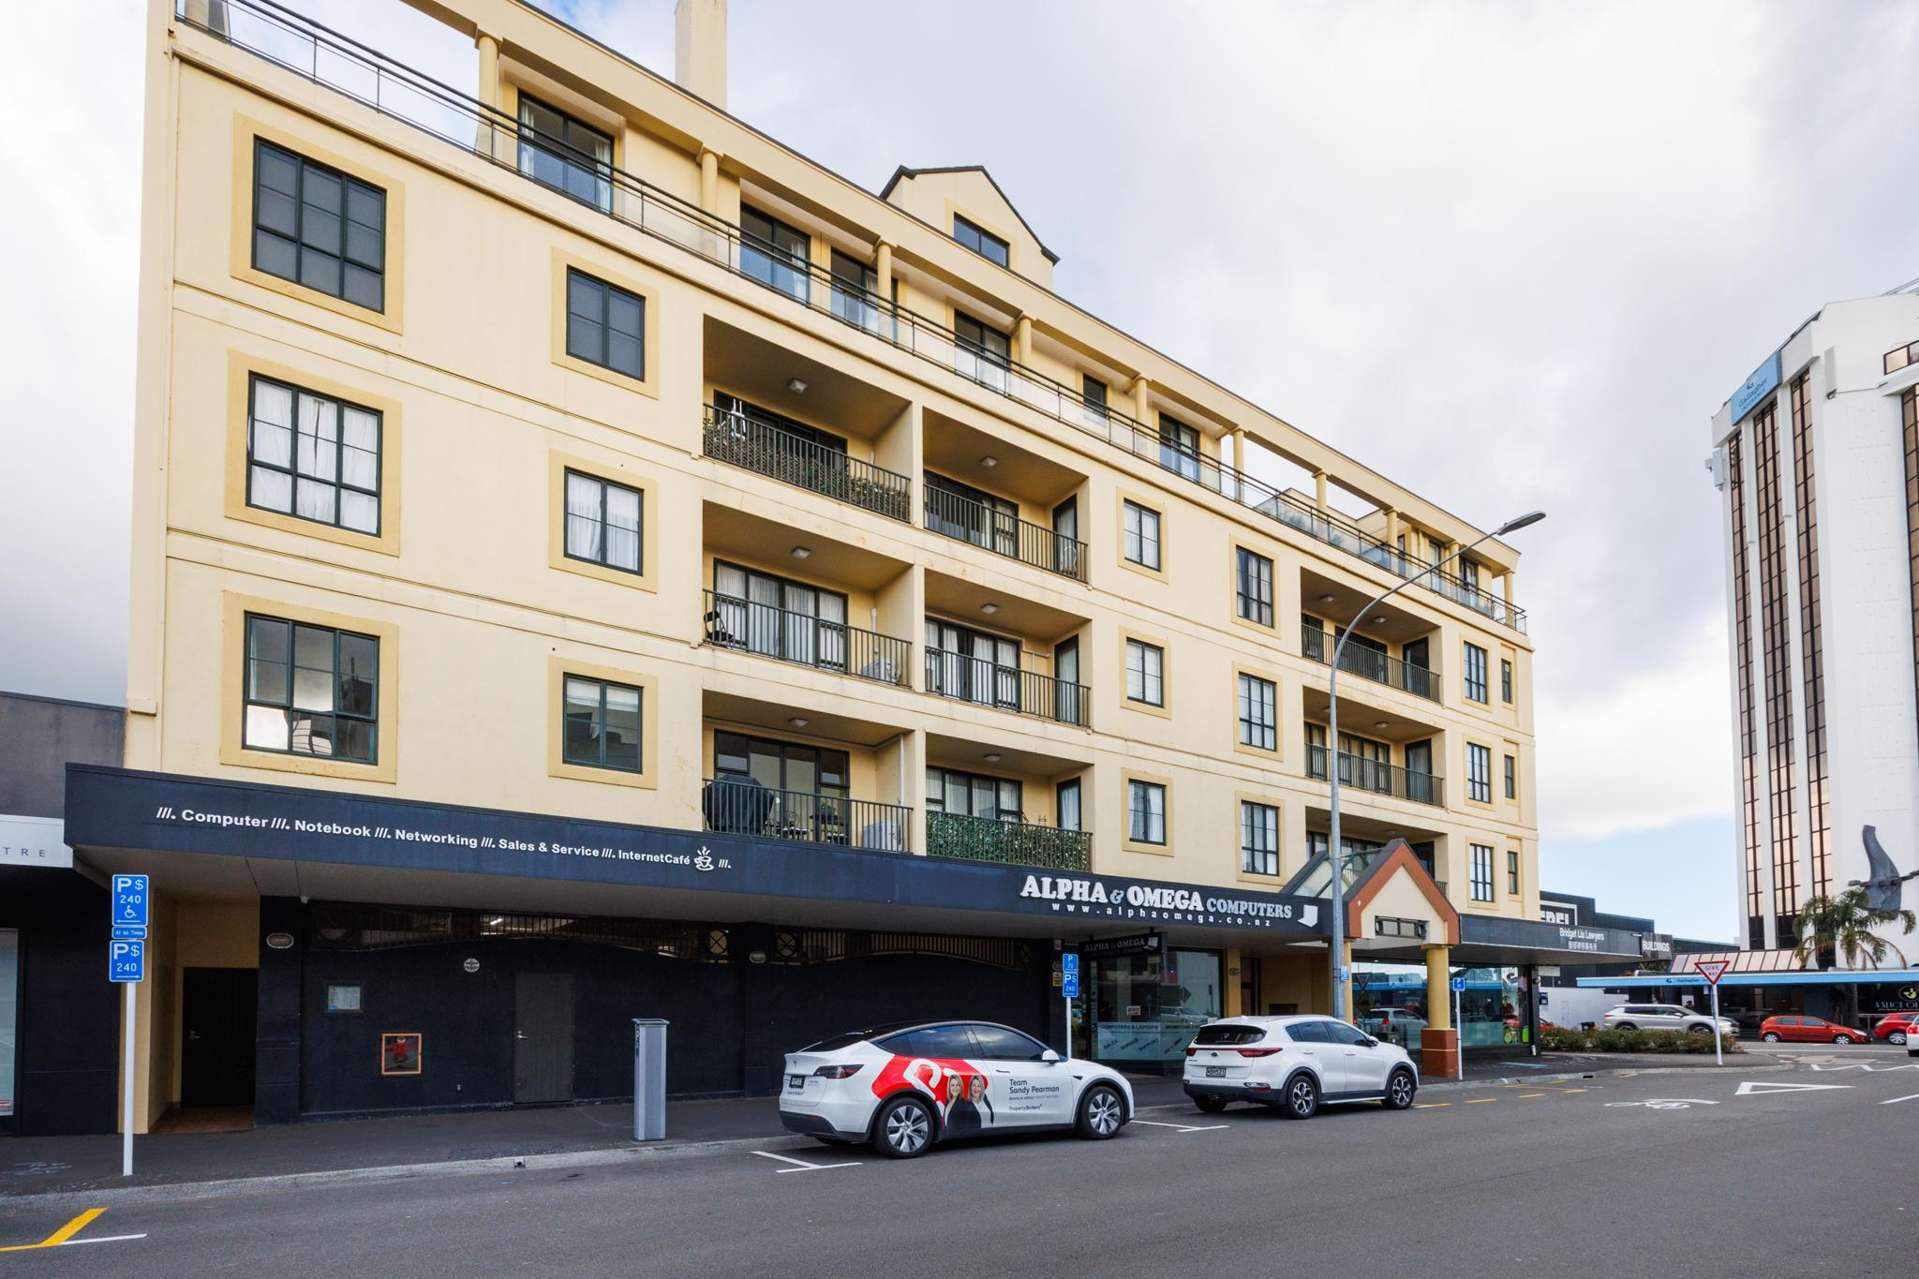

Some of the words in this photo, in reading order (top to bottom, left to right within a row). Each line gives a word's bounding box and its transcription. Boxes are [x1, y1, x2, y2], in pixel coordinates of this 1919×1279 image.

[181, 809, 269, 828] Computer
[294, 819, 371, 838] Notebook
[395, 828, 478, 849] Networking
[498, 838, 535, 852] Sales
[537, 841, 548, 853] &
[551, 843, 600, 857] Service
[618, 849, 691, 865] InternetCafé
[117, 877, 132, 893] P
[134, 878, 144, 891] $
[119, 894, 142, 904] 240
[1020, 874, 1108, 903] ALPHA
[1110, 889, 1125, 905] &
[1126, 885, 1205, 912] OMEGA
[1206, 897, 1292, 919] COMPUTERS
[1051, 903, 1271, 927] www.alphaomega.co.nz
[113, 943, 129, 960] P
[130, 944, 140, 958] $
[116, 962, 137, 972] 240
[1064, 974, 1071, 983] P
[1009, 1078, 1028, 1087] Team
[1009, 1087, 1030, 1096] Sandy
[1031, 1086, 1060, 1094] Pearman
